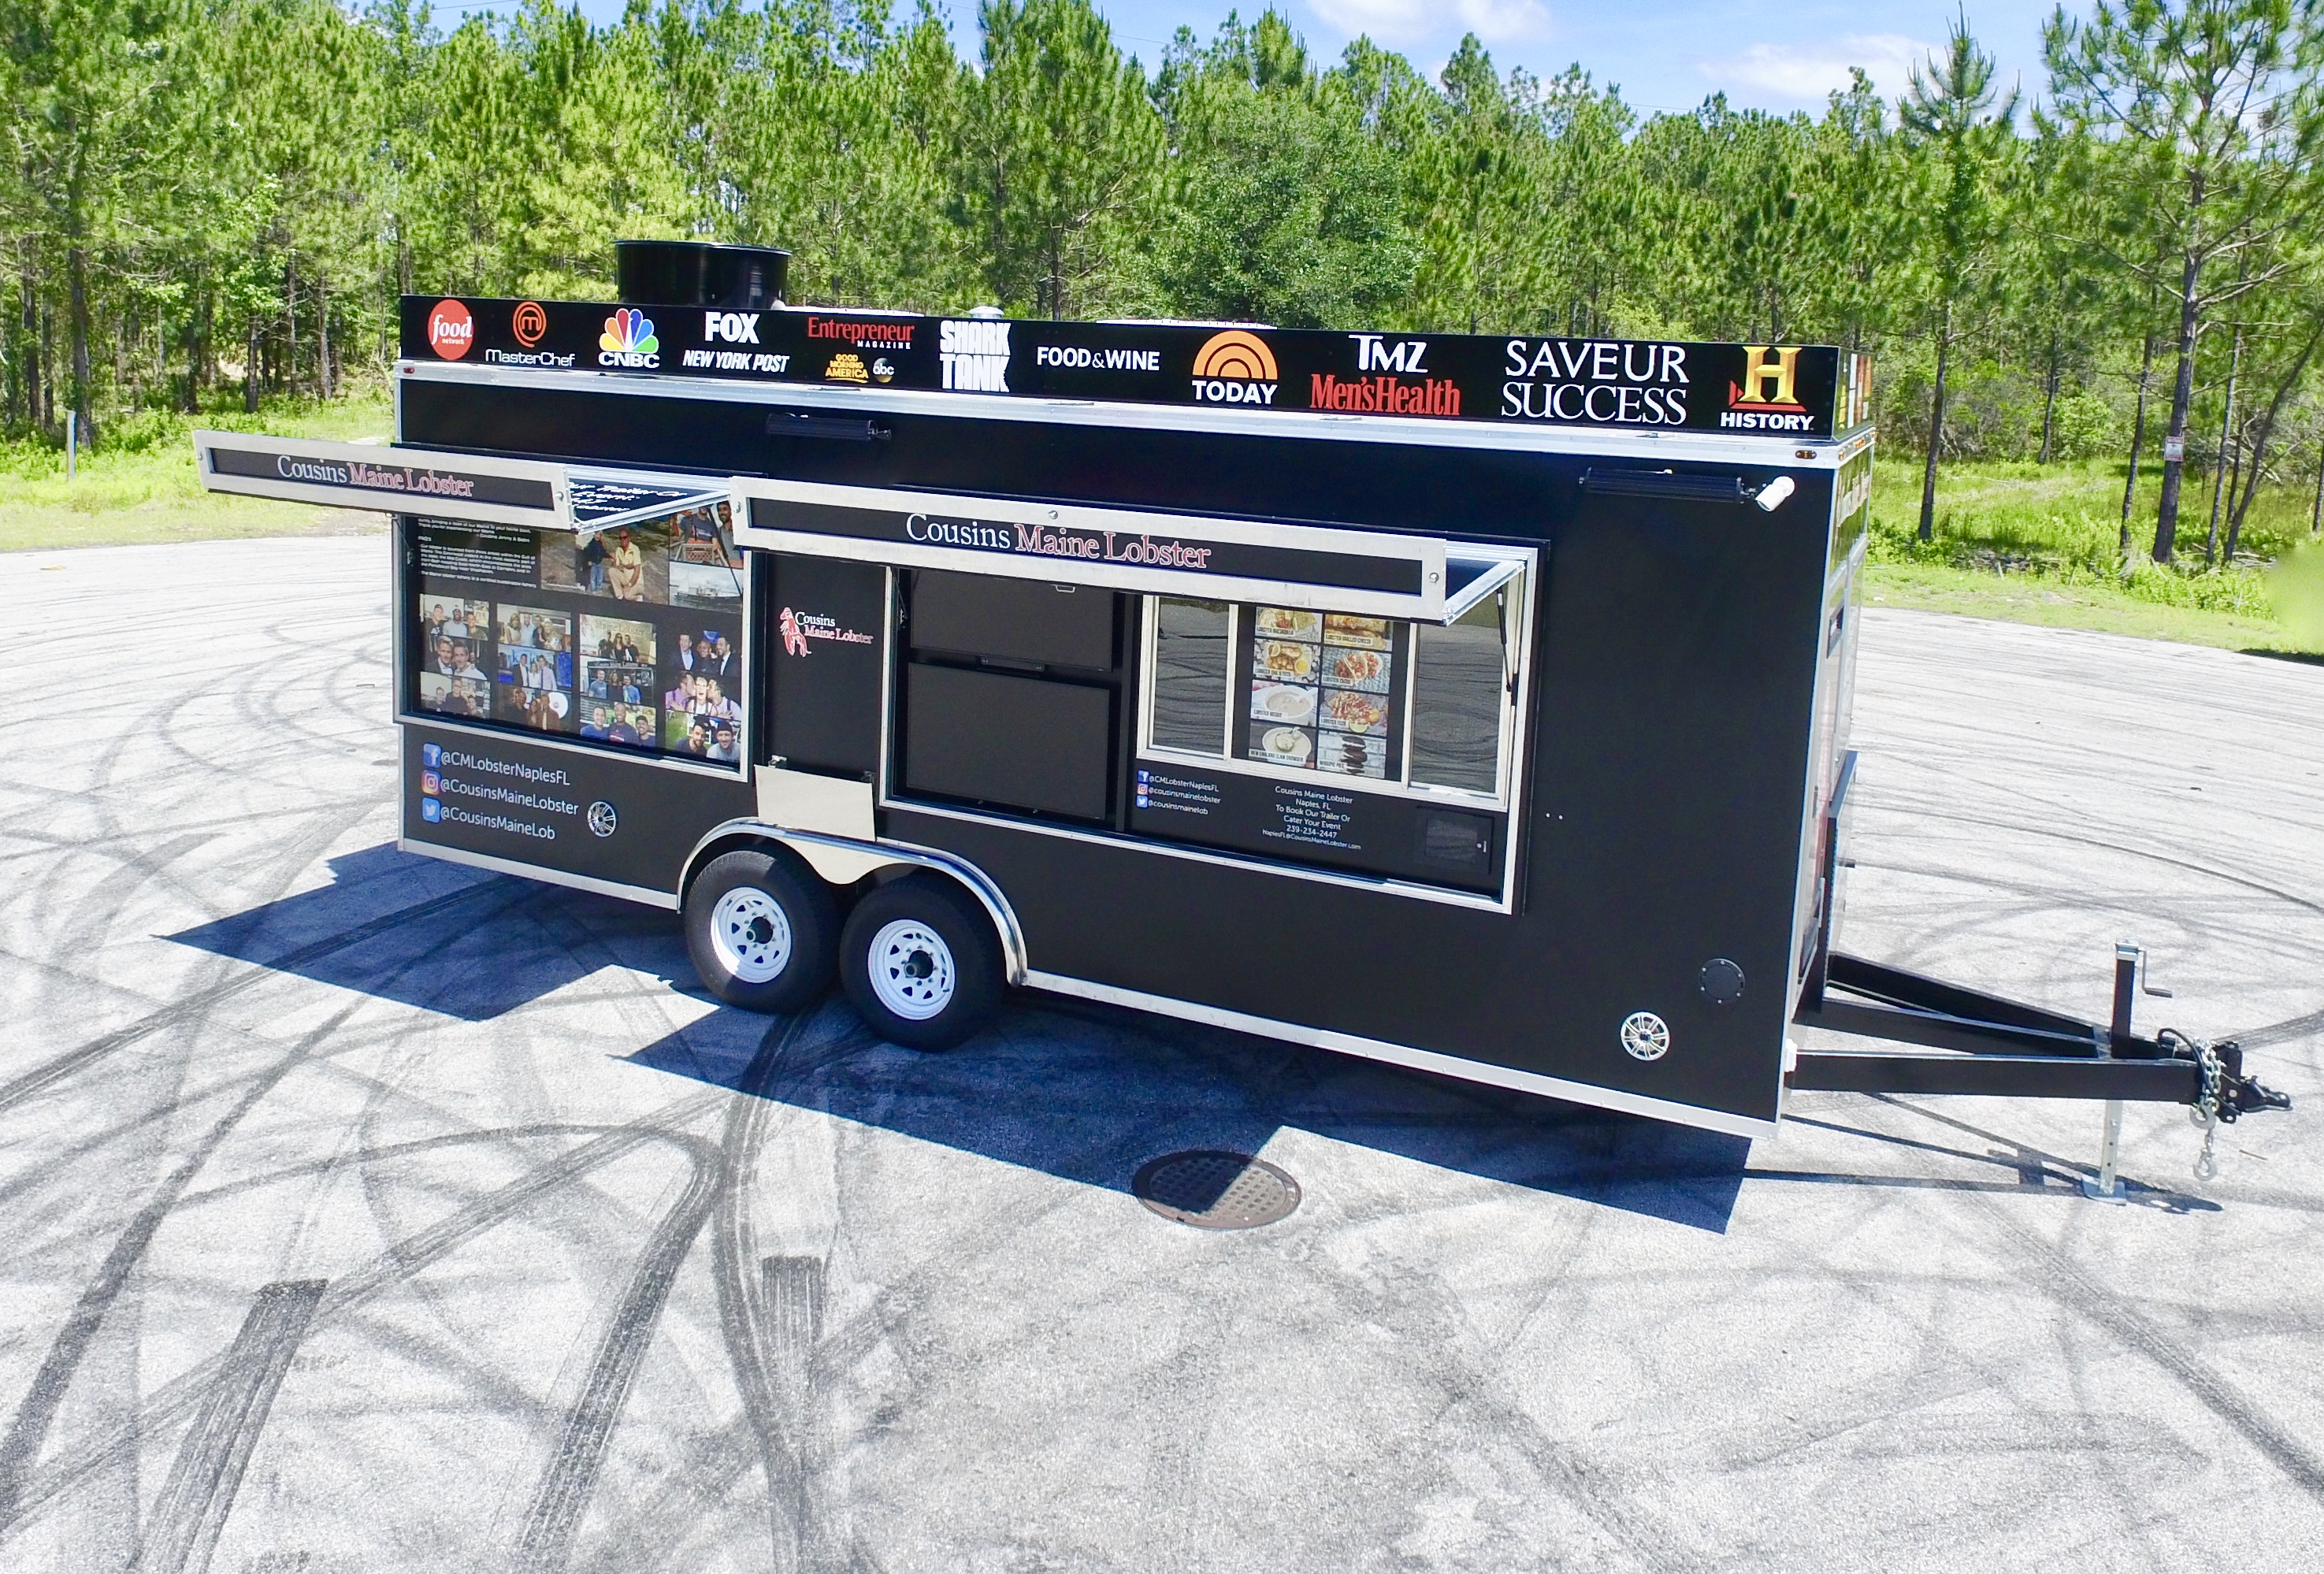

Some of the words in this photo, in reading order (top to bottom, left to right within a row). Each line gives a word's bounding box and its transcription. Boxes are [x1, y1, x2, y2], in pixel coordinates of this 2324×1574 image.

[430, 312, 473, 346] food
[705, 311, 759, 344] FOX
[807, 317, 915, 344] Entrepreneur
[939, 320, 1012, 356] SHARK
[485, 348, 575, 366] MasterChef
[835, 353, 859, 362] GOOD
[857, 340, 911, 350] MAGAZINE
[1348, 334, 1428, 373] TMZ
[598, 351, 660, 369] CNBC
[683, 349, 716, 368] NEW
[716, 351, 751, 370] YORK
[752, 354, 790, 373] POST
[825, 367, 869, 378] AMERICA
[872, 362, 895, 376] abc
[1504, 340, 1690, 384] SAVEUR
[939, 355, 1011, 392] TANK
[1193, 379, 1279, 405] TODAY
[1501, 381, 1688, 425] SUCCESS
[1721, 411, 1814, 431] HISTORY
[277, 455, 348, 484] Cousins
[347, 462, 405, 490] Maine
[405, 468, 475, 498] Lobster
[906, 512, 1012, 550] Cousins
[1013, 522, 1101, 559] Maine
[1103, 530, 1212, 570] Lobster
[794, 611, 836, 628] Cousins
[804, 624, 835, 640] Maine
[835, 628, 874, 644] Lobster
[440, 751, 570, 786] @CMLobsterNaplesFL
[440, 778, 580, 816] @CousinsMaineLobster
[1275, 785, 1302, 796] Cousins
[1326, 793, 1353, 804] Lobster
[1322, 802, 1331, 811] FL
[440, 806, 556, 841] @CousinsMaineLob
[1286, 805, 1304, 815] Book
[1305, 808, 1320, 817] Our
